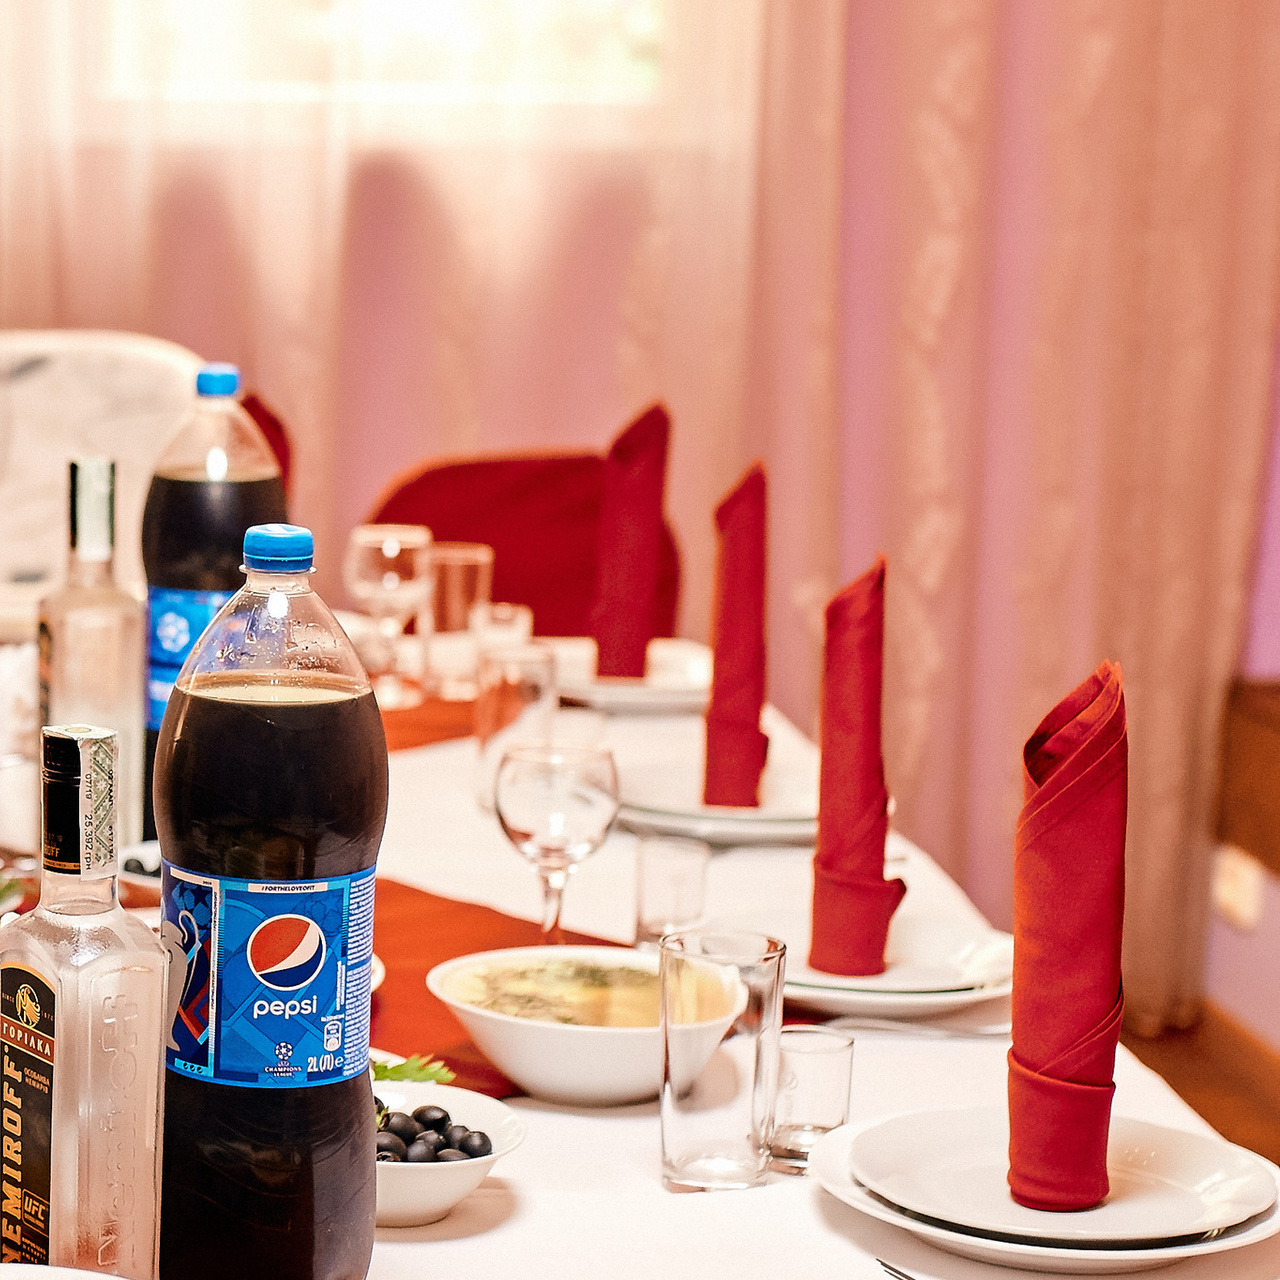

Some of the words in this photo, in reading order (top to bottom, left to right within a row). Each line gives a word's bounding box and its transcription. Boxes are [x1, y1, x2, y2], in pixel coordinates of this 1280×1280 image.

[84, 814, 93, 850] 25,392
[253, 995, 317, 1020] pepsi
[3, 1023, 51, 1056] ГОРІЛКА
[24, 1196, 46, 1221] UFC
